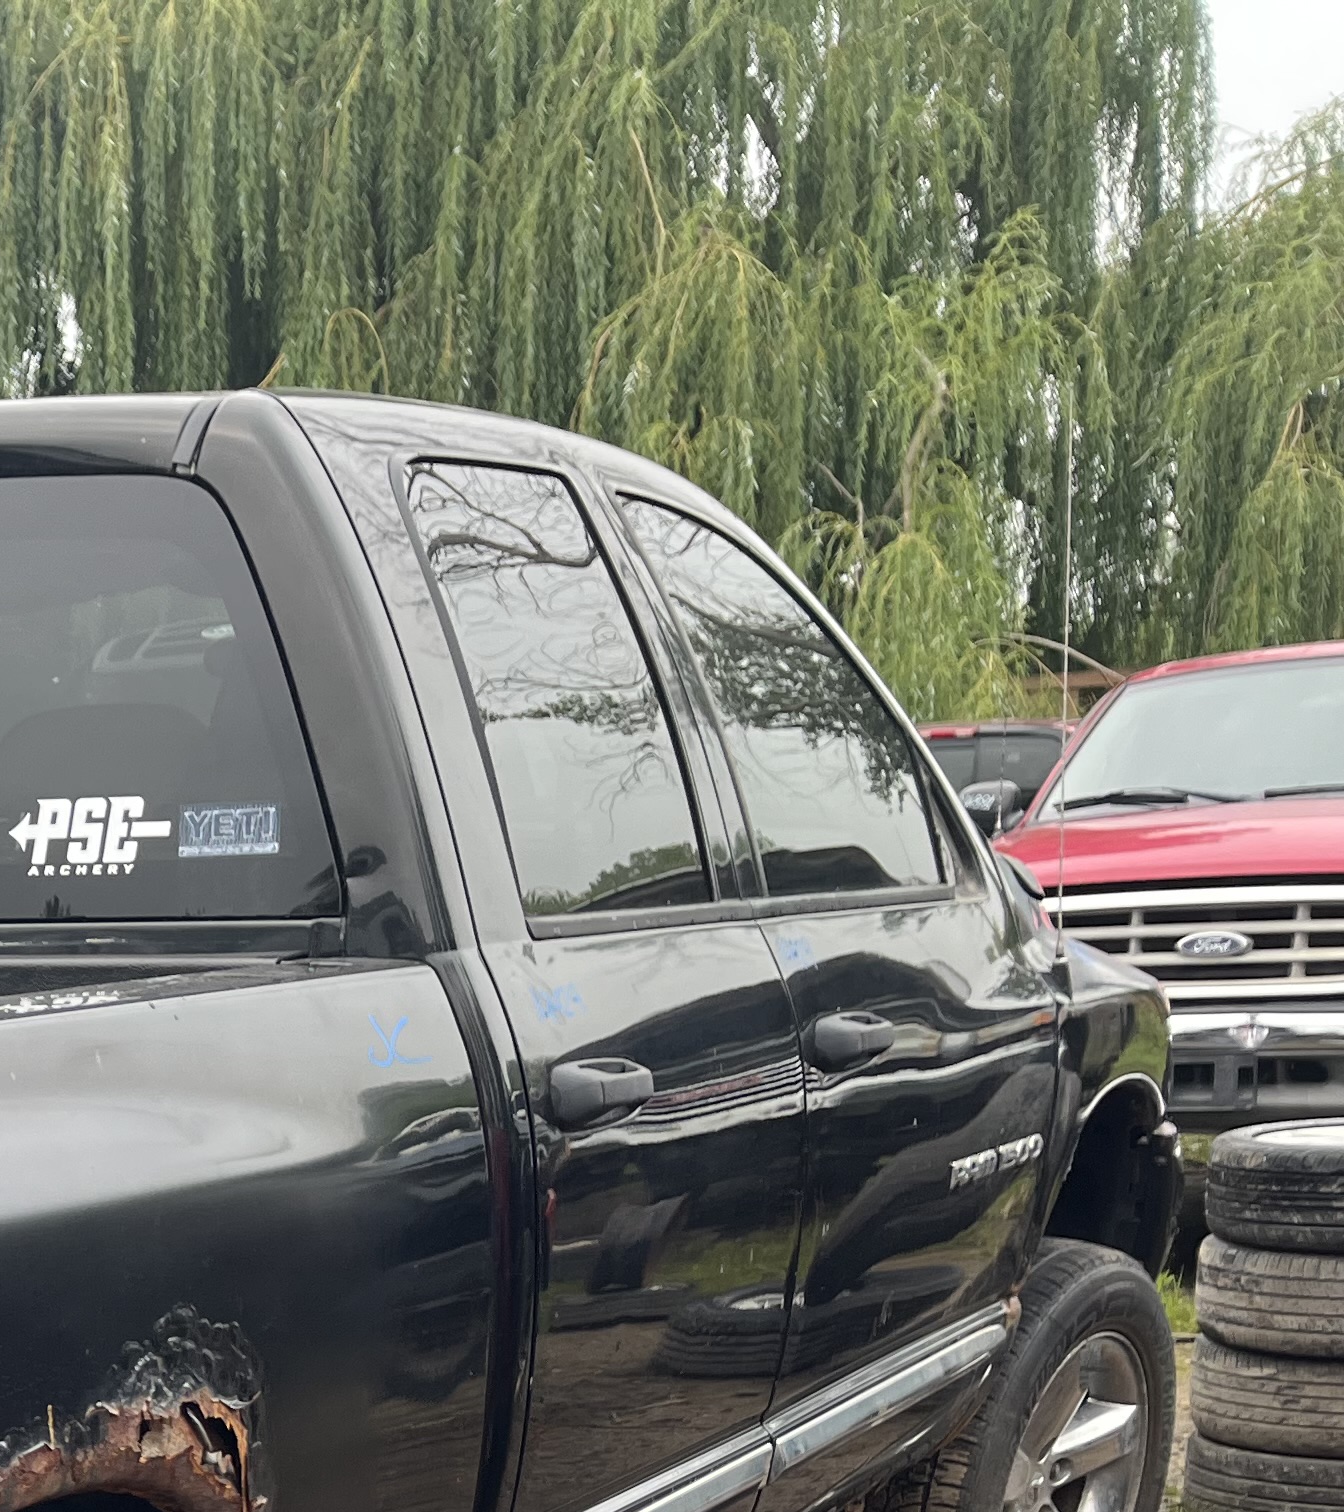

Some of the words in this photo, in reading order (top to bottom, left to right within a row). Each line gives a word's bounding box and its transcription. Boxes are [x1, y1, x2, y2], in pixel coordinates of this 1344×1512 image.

[30, 795, 148, 864] PSE
[183, 805, 277, 841] YETI
[26, 863, 136, 877] ARCHERY
